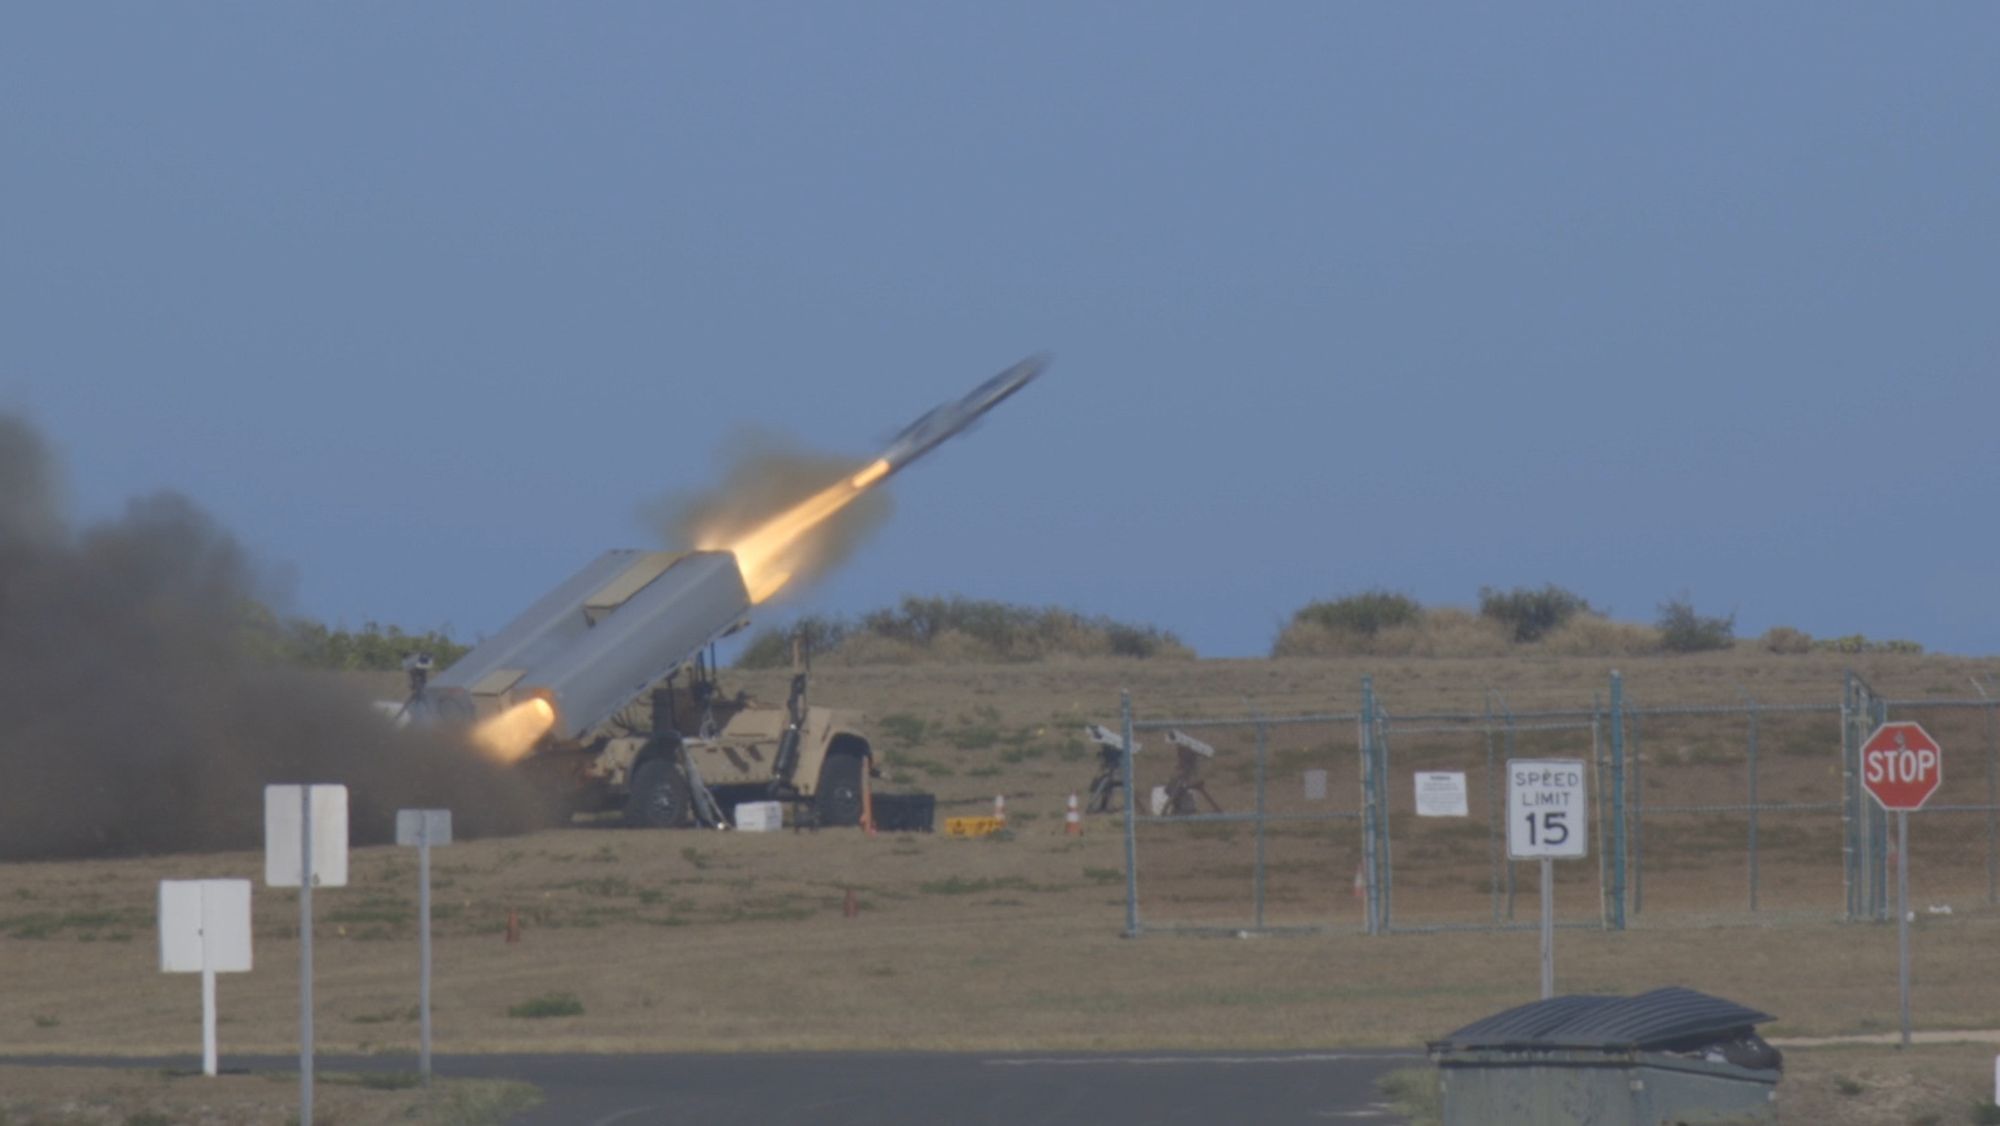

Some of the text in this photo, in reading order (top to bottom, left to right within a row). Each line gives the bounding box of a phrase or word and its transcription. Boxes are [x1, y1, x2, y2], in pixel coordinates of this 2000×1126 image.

[1867, 750, 1935, 783] STOP
[1515, 772, 1578, 787] SPEED
[1522, 792, 1571, 807] LIMIT
[1525, 812, 1569, 846] 15
